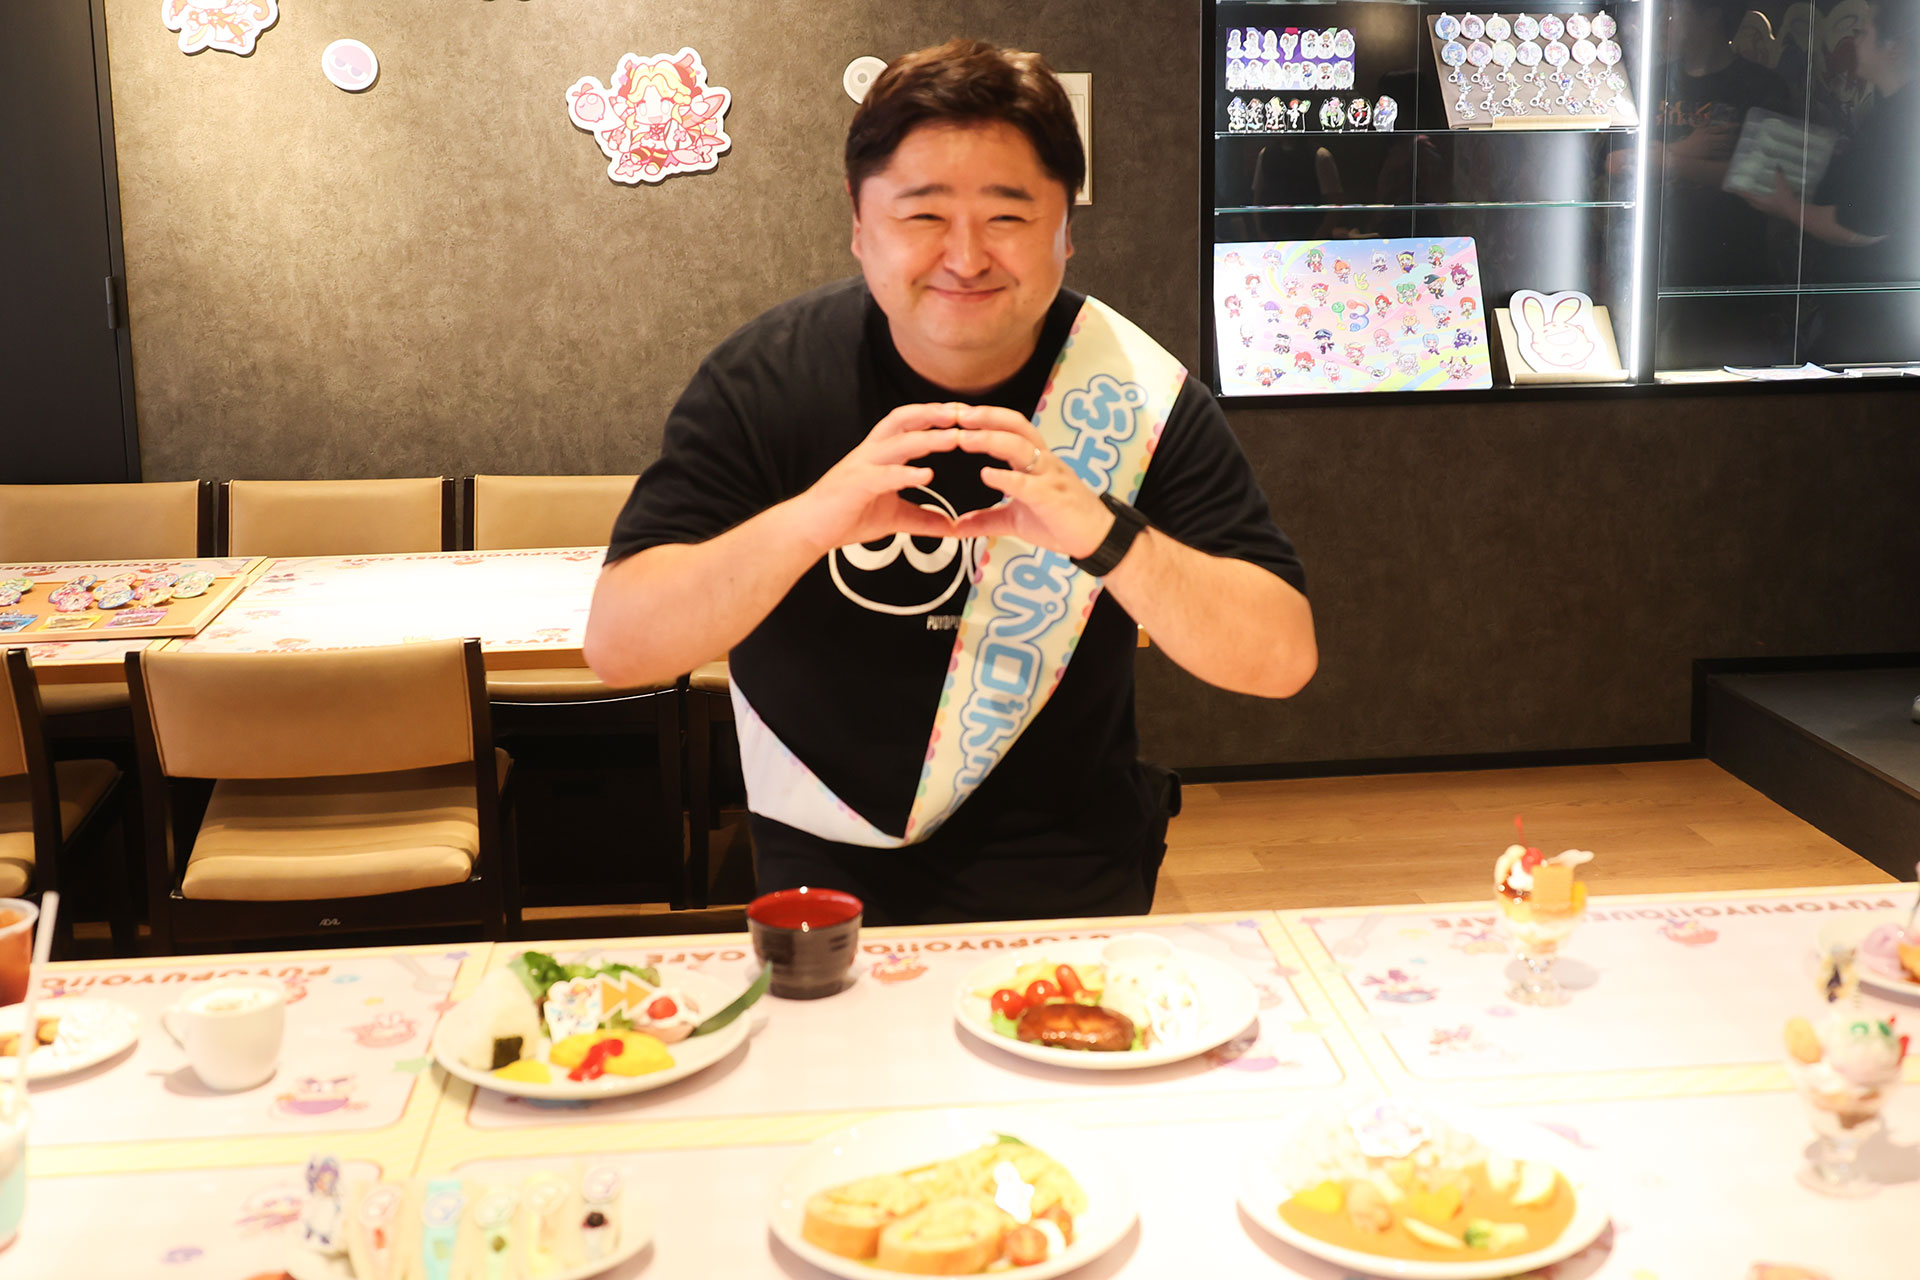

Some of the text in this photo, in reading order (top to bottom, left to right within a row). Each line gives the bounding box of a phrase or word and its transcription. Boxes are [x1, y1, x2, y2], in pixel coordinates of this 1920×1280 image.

[0, 562, 182, 571] PUYOPUYO!!QUE
[1431, 899, 1897, 929] PUYOPUYO!!QUE AFE
[645, 950, 746, 967] CAFE
